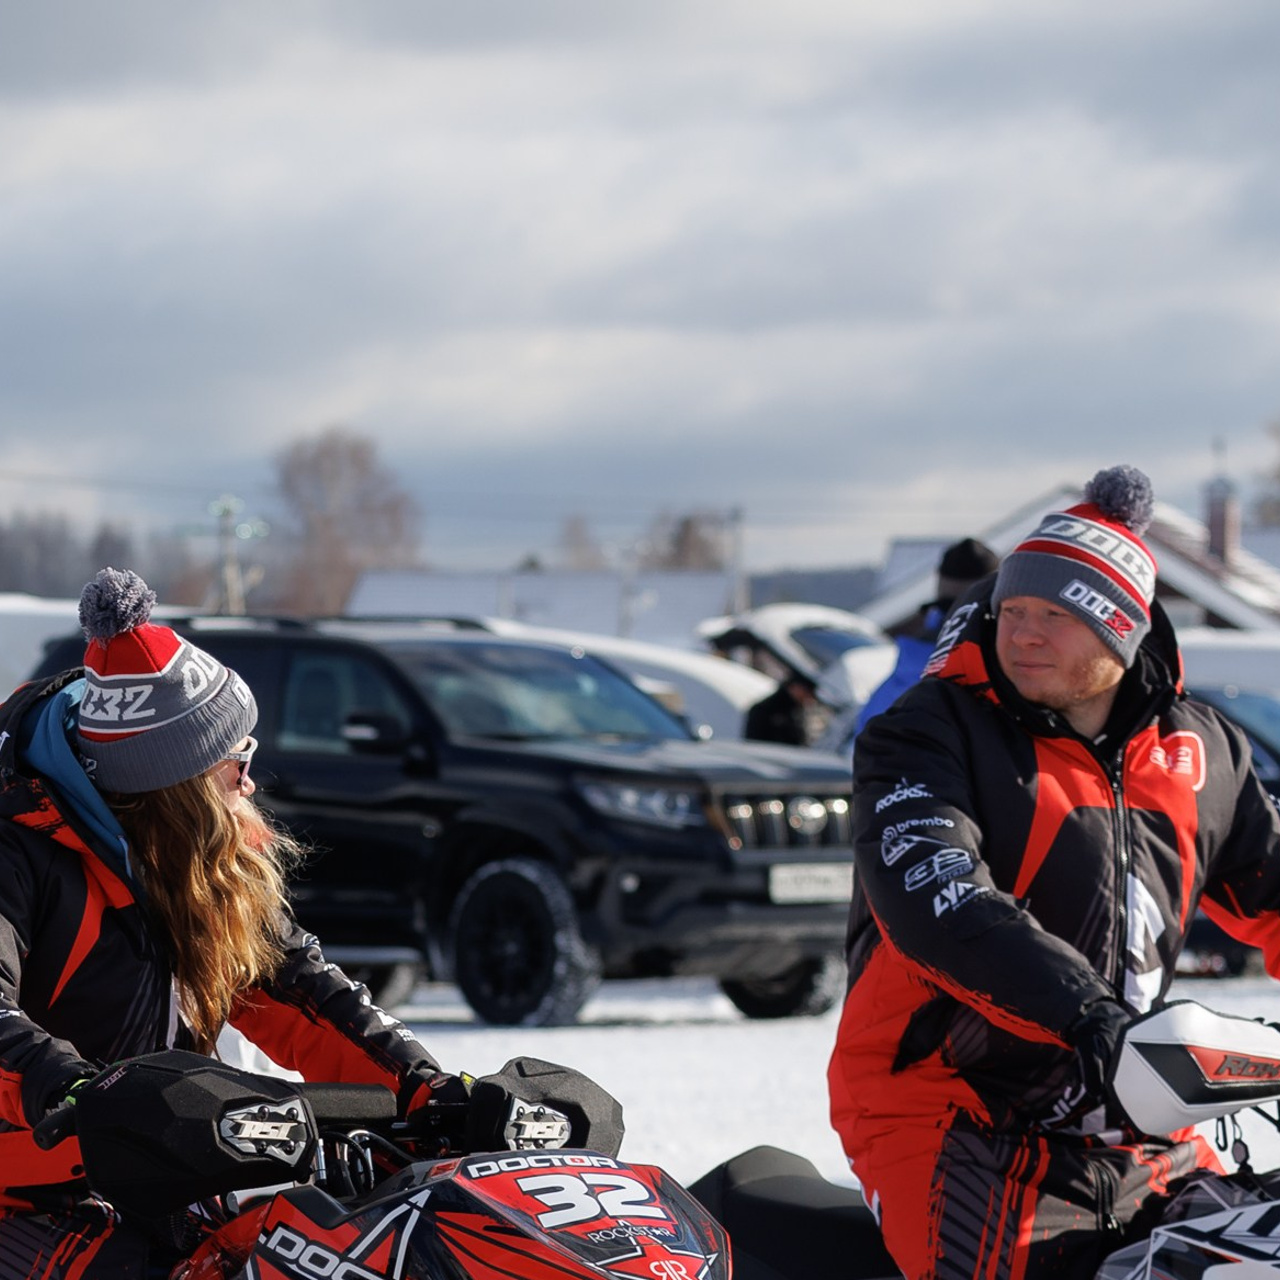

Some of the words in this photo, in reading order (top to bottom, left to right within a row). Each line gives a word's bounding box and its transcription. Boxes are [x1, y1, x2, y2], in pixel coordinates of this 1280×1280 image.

[896, 816, 955, 833] brembo
[467, 1155, 619, 1179] DOCTOR
[516, 1172, 668, 1229] 32
